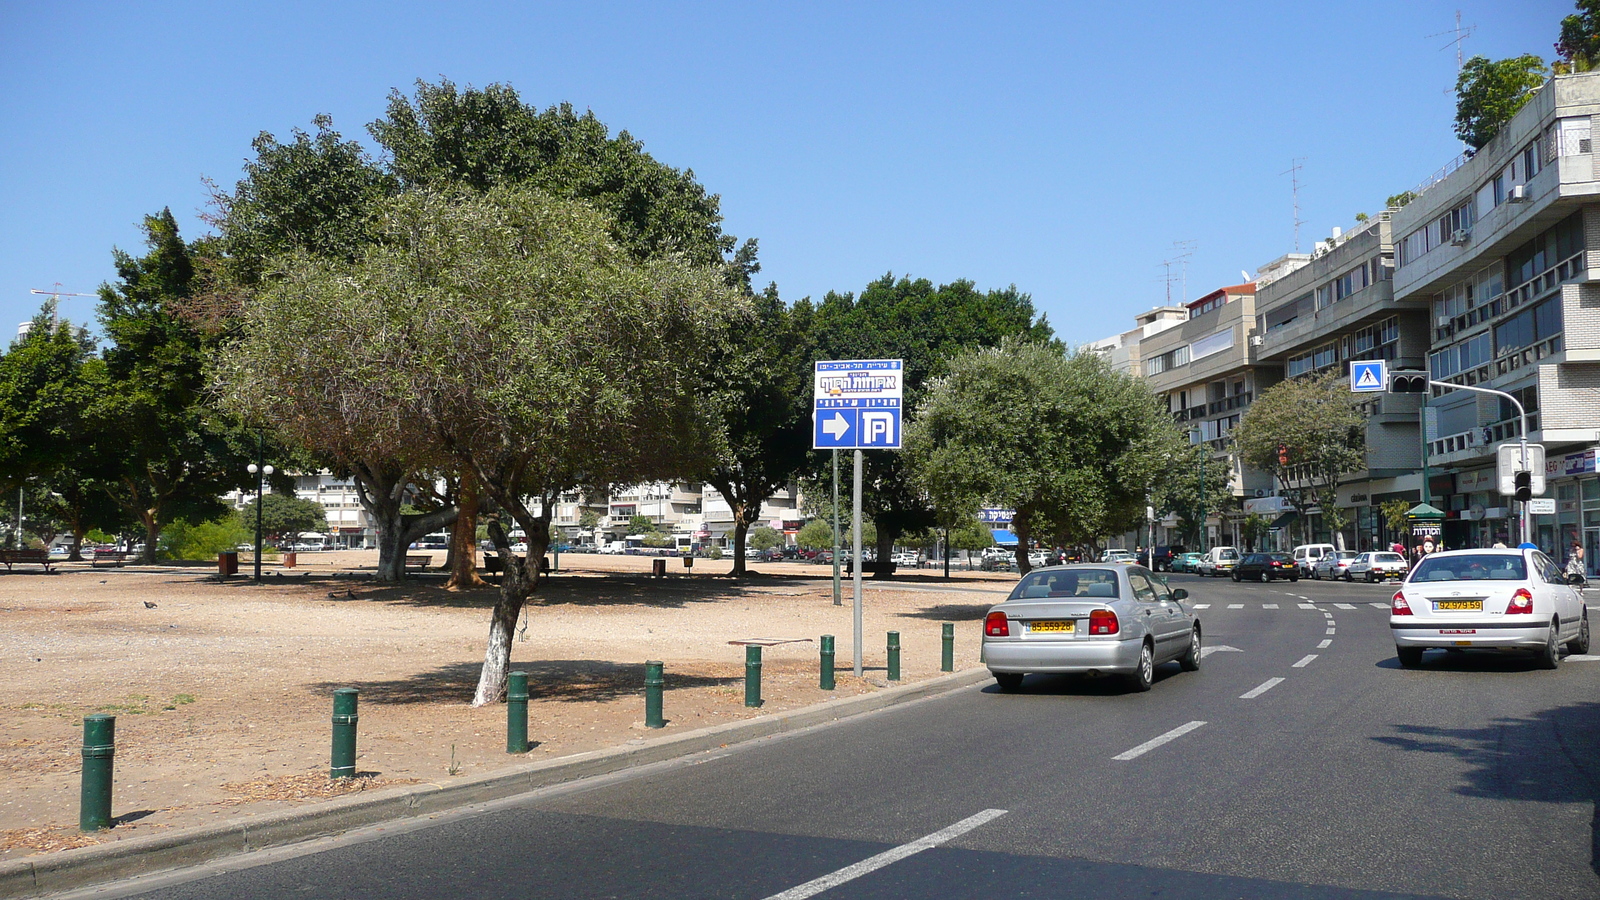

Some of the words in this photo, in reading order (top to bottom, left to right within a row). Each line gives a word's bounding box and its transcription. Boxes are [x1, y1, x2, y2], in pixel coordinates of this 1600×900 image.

[819, 362, 863, 370] תל-אביב-יפו
[819, 399, 858, 407] עירוני
[866, 399, 897, 407] חניון
